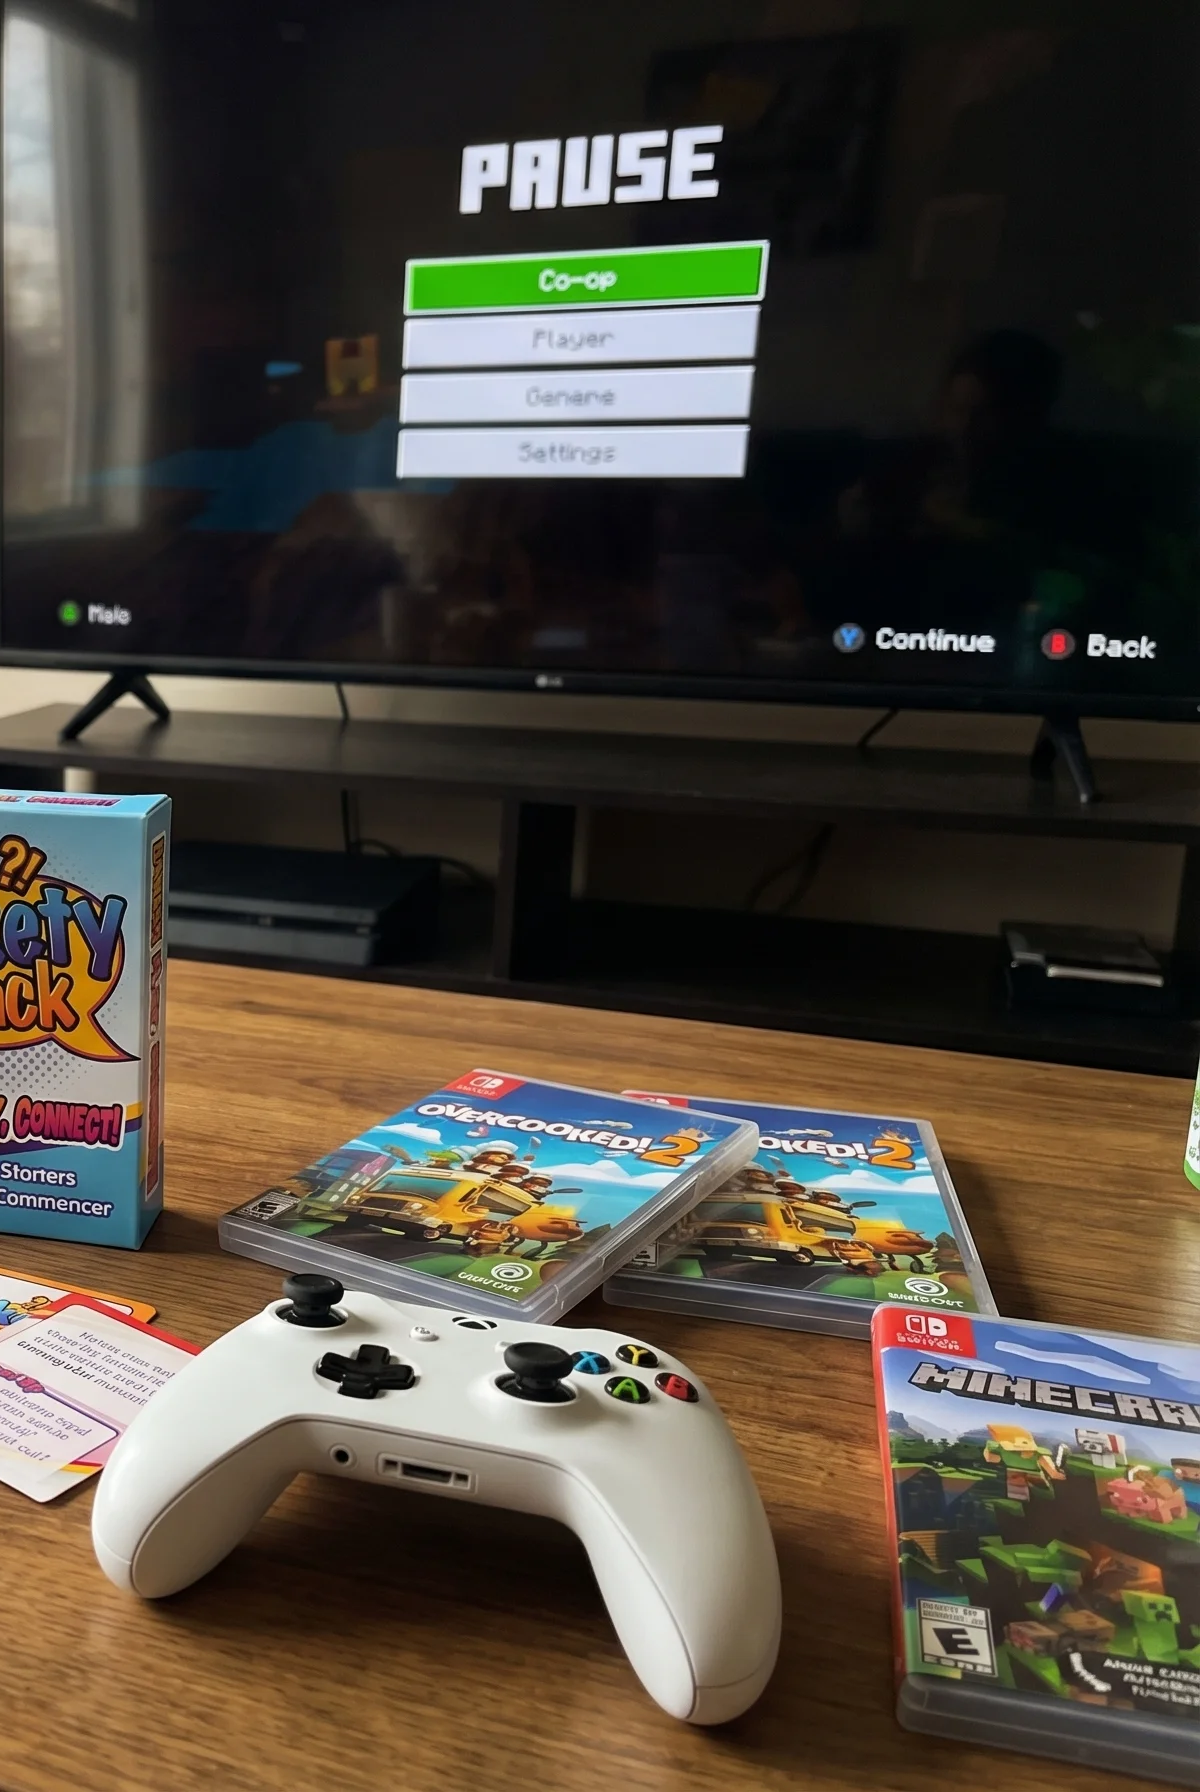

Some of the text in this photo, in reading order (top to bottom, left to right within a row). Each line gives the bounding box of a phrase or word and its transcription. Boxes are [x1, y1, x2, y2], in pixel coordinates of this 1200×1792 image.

[459, 125, 724, 214] PAUSE
[538, 268, 618, 293] Co-op
[875, 627, 996, 654] Continue
[1086, 633, 1157, 660] Back
[13, 1095, 124, 1147] CONNECT!
[416, 1102, 702, 1166] OVERCOOKED! 2
[759, 1136, 916, 1171] OKED! 2
[574, 1351, 601, 1375] X
[627, 1345, 649, 1366] Y
[612, 1378, 640, 1401] A
[908, 1361, 1200, 1432] MINECRA
[932, 1627, 980, 1656] E
